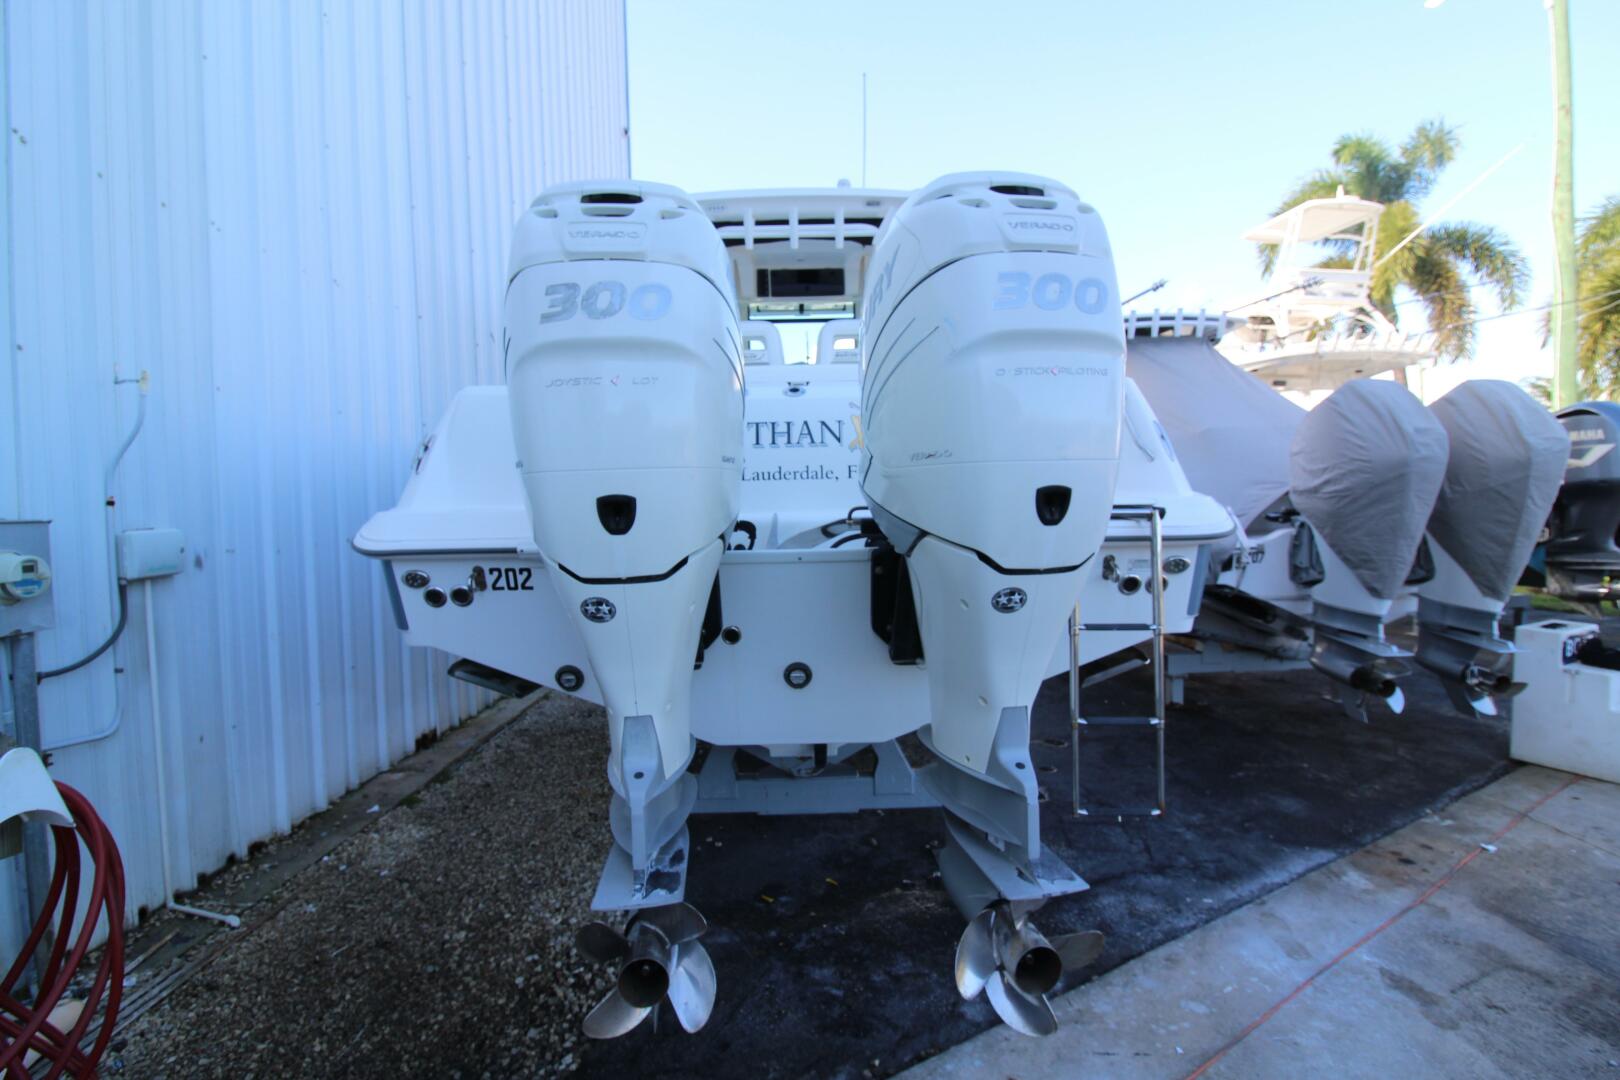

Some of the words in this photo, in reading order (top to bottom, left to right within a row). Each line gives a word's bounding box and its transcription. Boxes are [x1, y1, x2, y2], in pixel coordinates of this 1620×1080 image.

[539, 280, 673, 325] 300
[992, 271, 1109, 315] 300
[747, 419, 844, 449] THAN
[741, 464, 839, 481] Lauderdale,
[489, 567, 534, 591] 202
